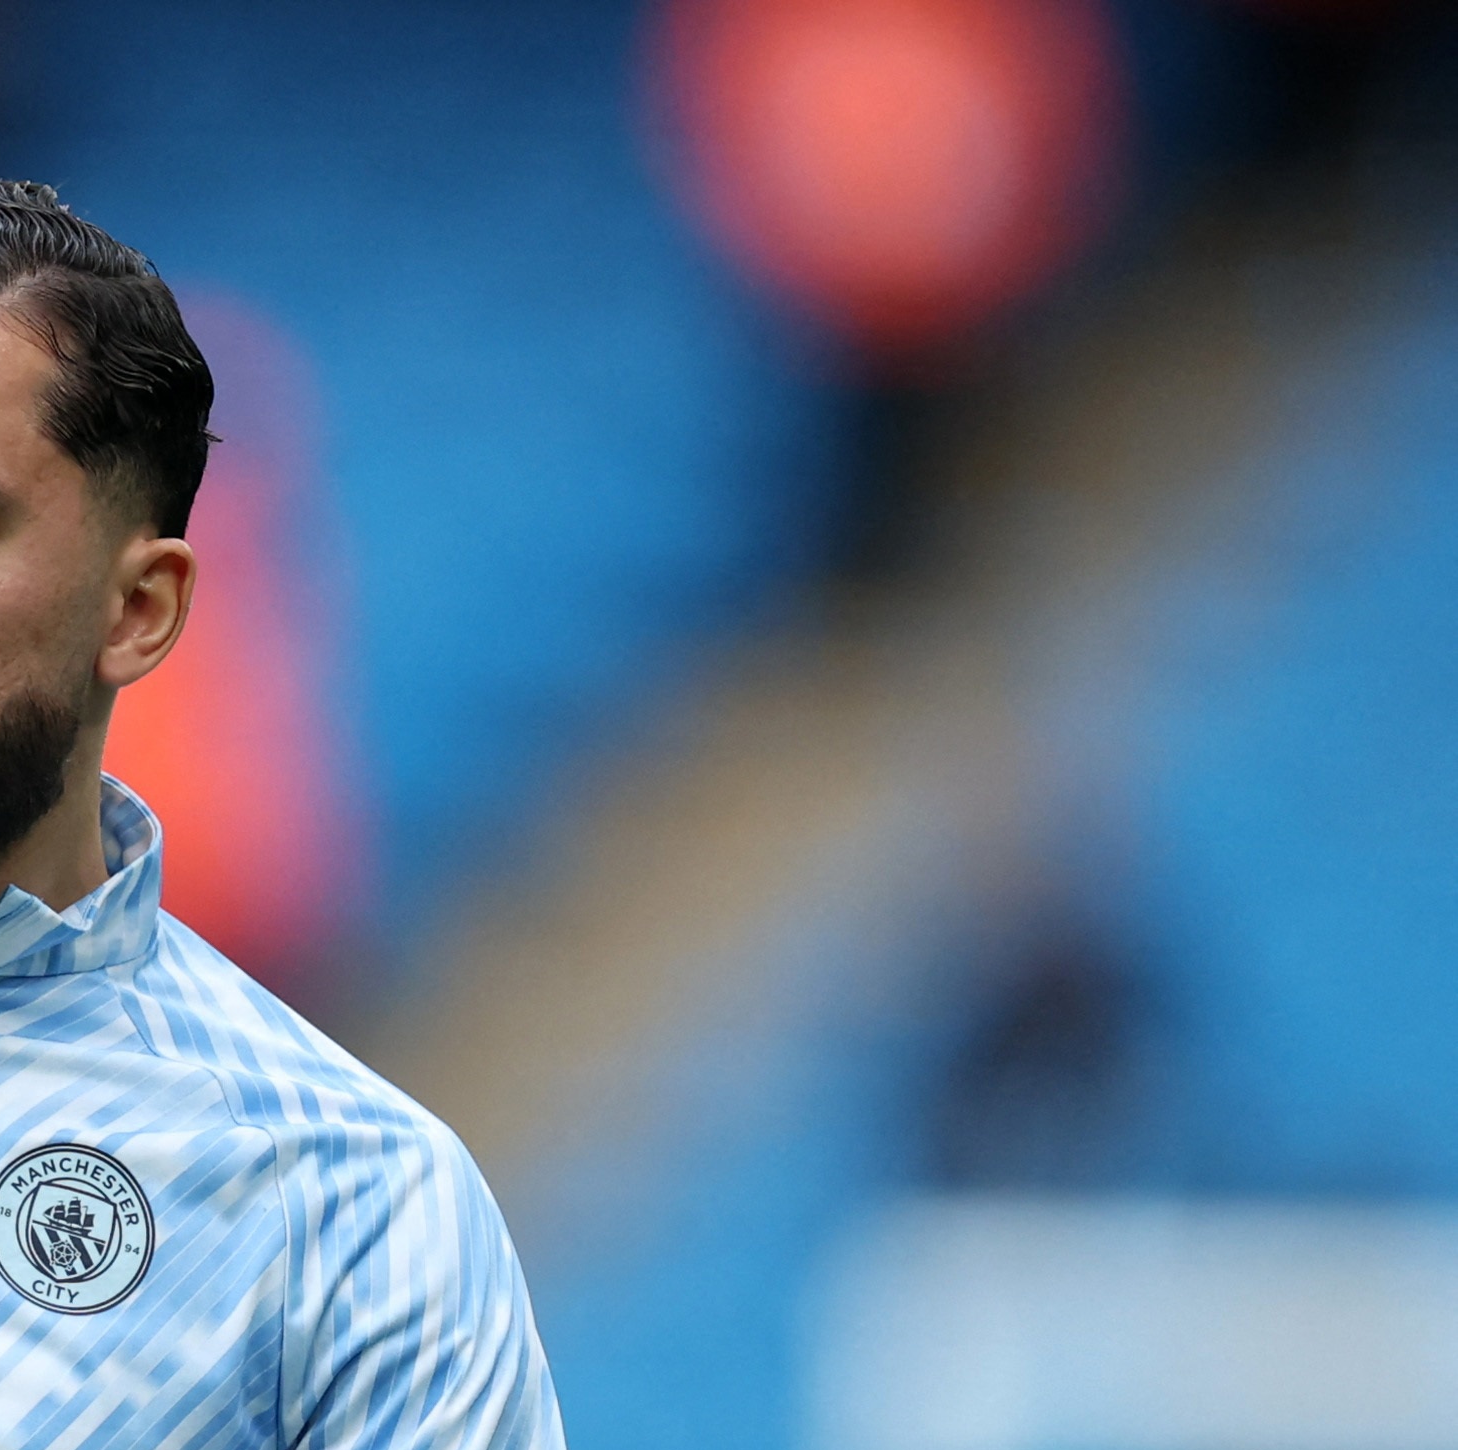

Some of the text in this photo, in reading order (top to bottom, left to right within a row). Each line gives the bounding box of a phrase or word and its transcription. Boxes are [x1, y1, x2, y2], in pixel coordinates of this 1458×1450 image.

[11, 1157, 140, 1227] MANCHESTER
[0, 1206, 12, 1218] 18
[124, 1244, 140, 1255] 94
[32, 1279, 80, 1304] CITY
